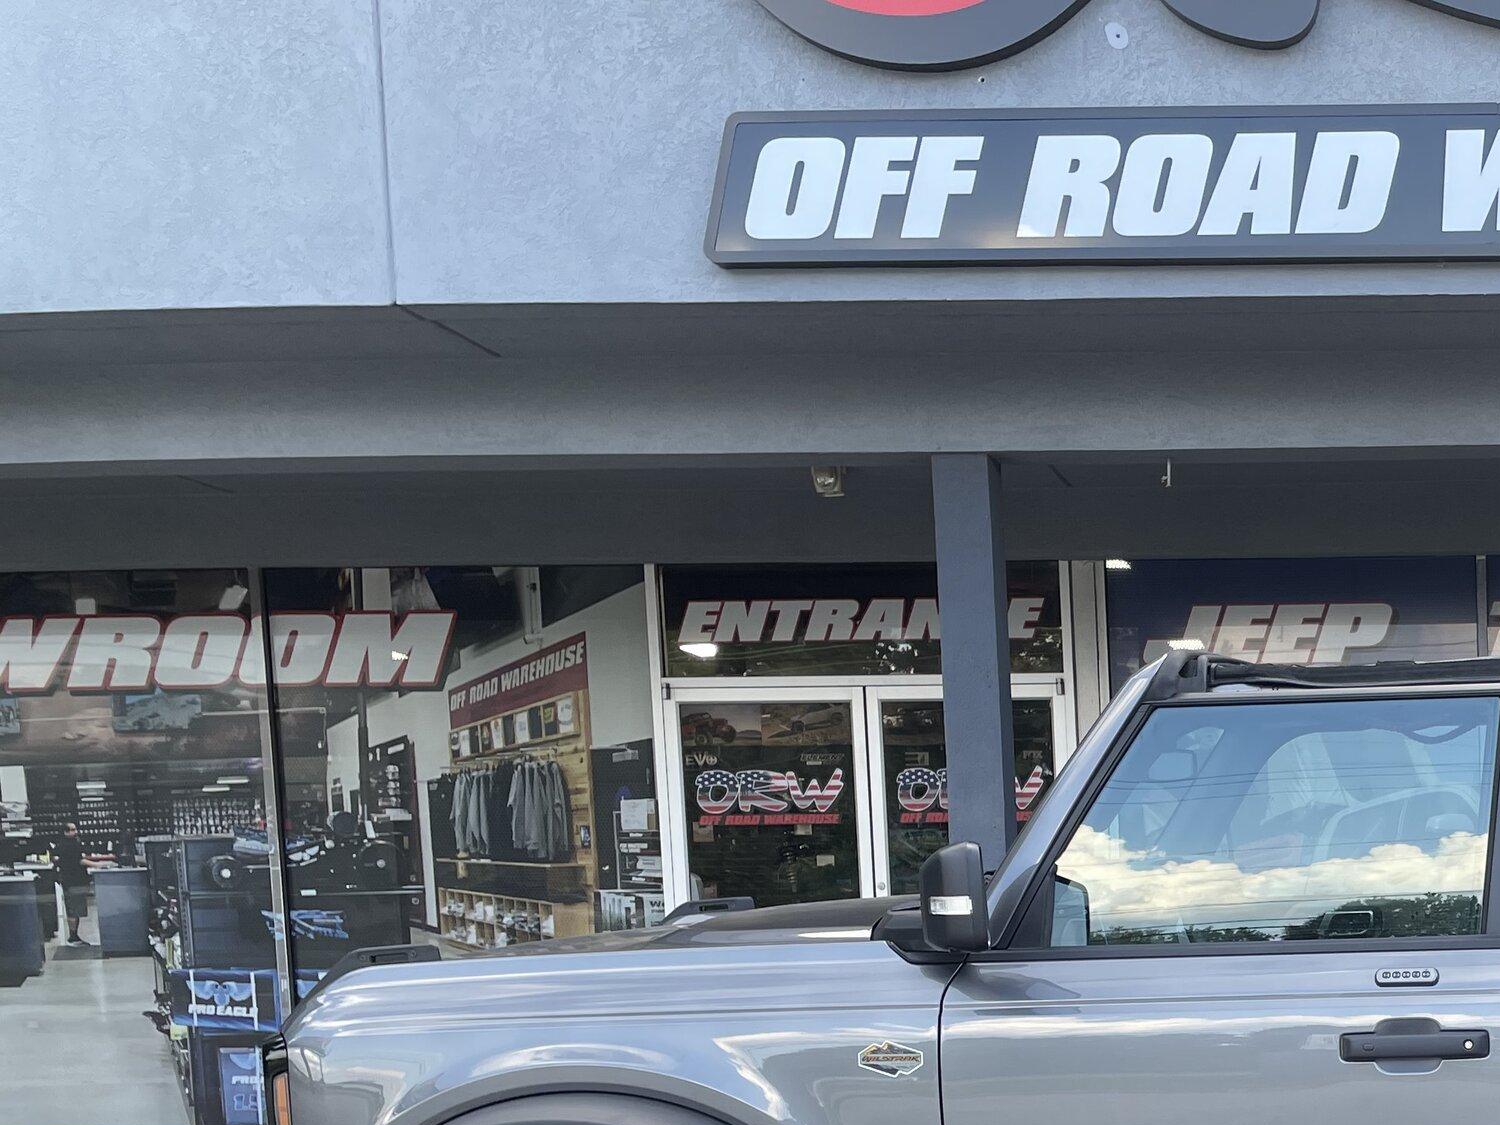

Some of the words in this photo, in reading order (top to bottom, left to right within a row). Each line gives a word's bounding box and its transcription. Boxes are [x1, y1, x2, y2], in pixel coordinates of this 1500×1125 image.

[745, 134, 985, 240] OFF
[1015, 130, 1400, 238] ROAD
[677, 598, 1044, 643] ENTRANE
[1143, 603, 1394, 664] JEEP
[451, 690, 466, 711] OFF
[469, 677, 499, 703] ROAD
[501, 641, 585, 692] WAREHOUSE
[695, 768, 844, 814] ORW
[724, 815, 760, 825] ROAD
[764, 814, 841, 825] WAREHOUSE
[188, 1004, 215, 1014] PRO
